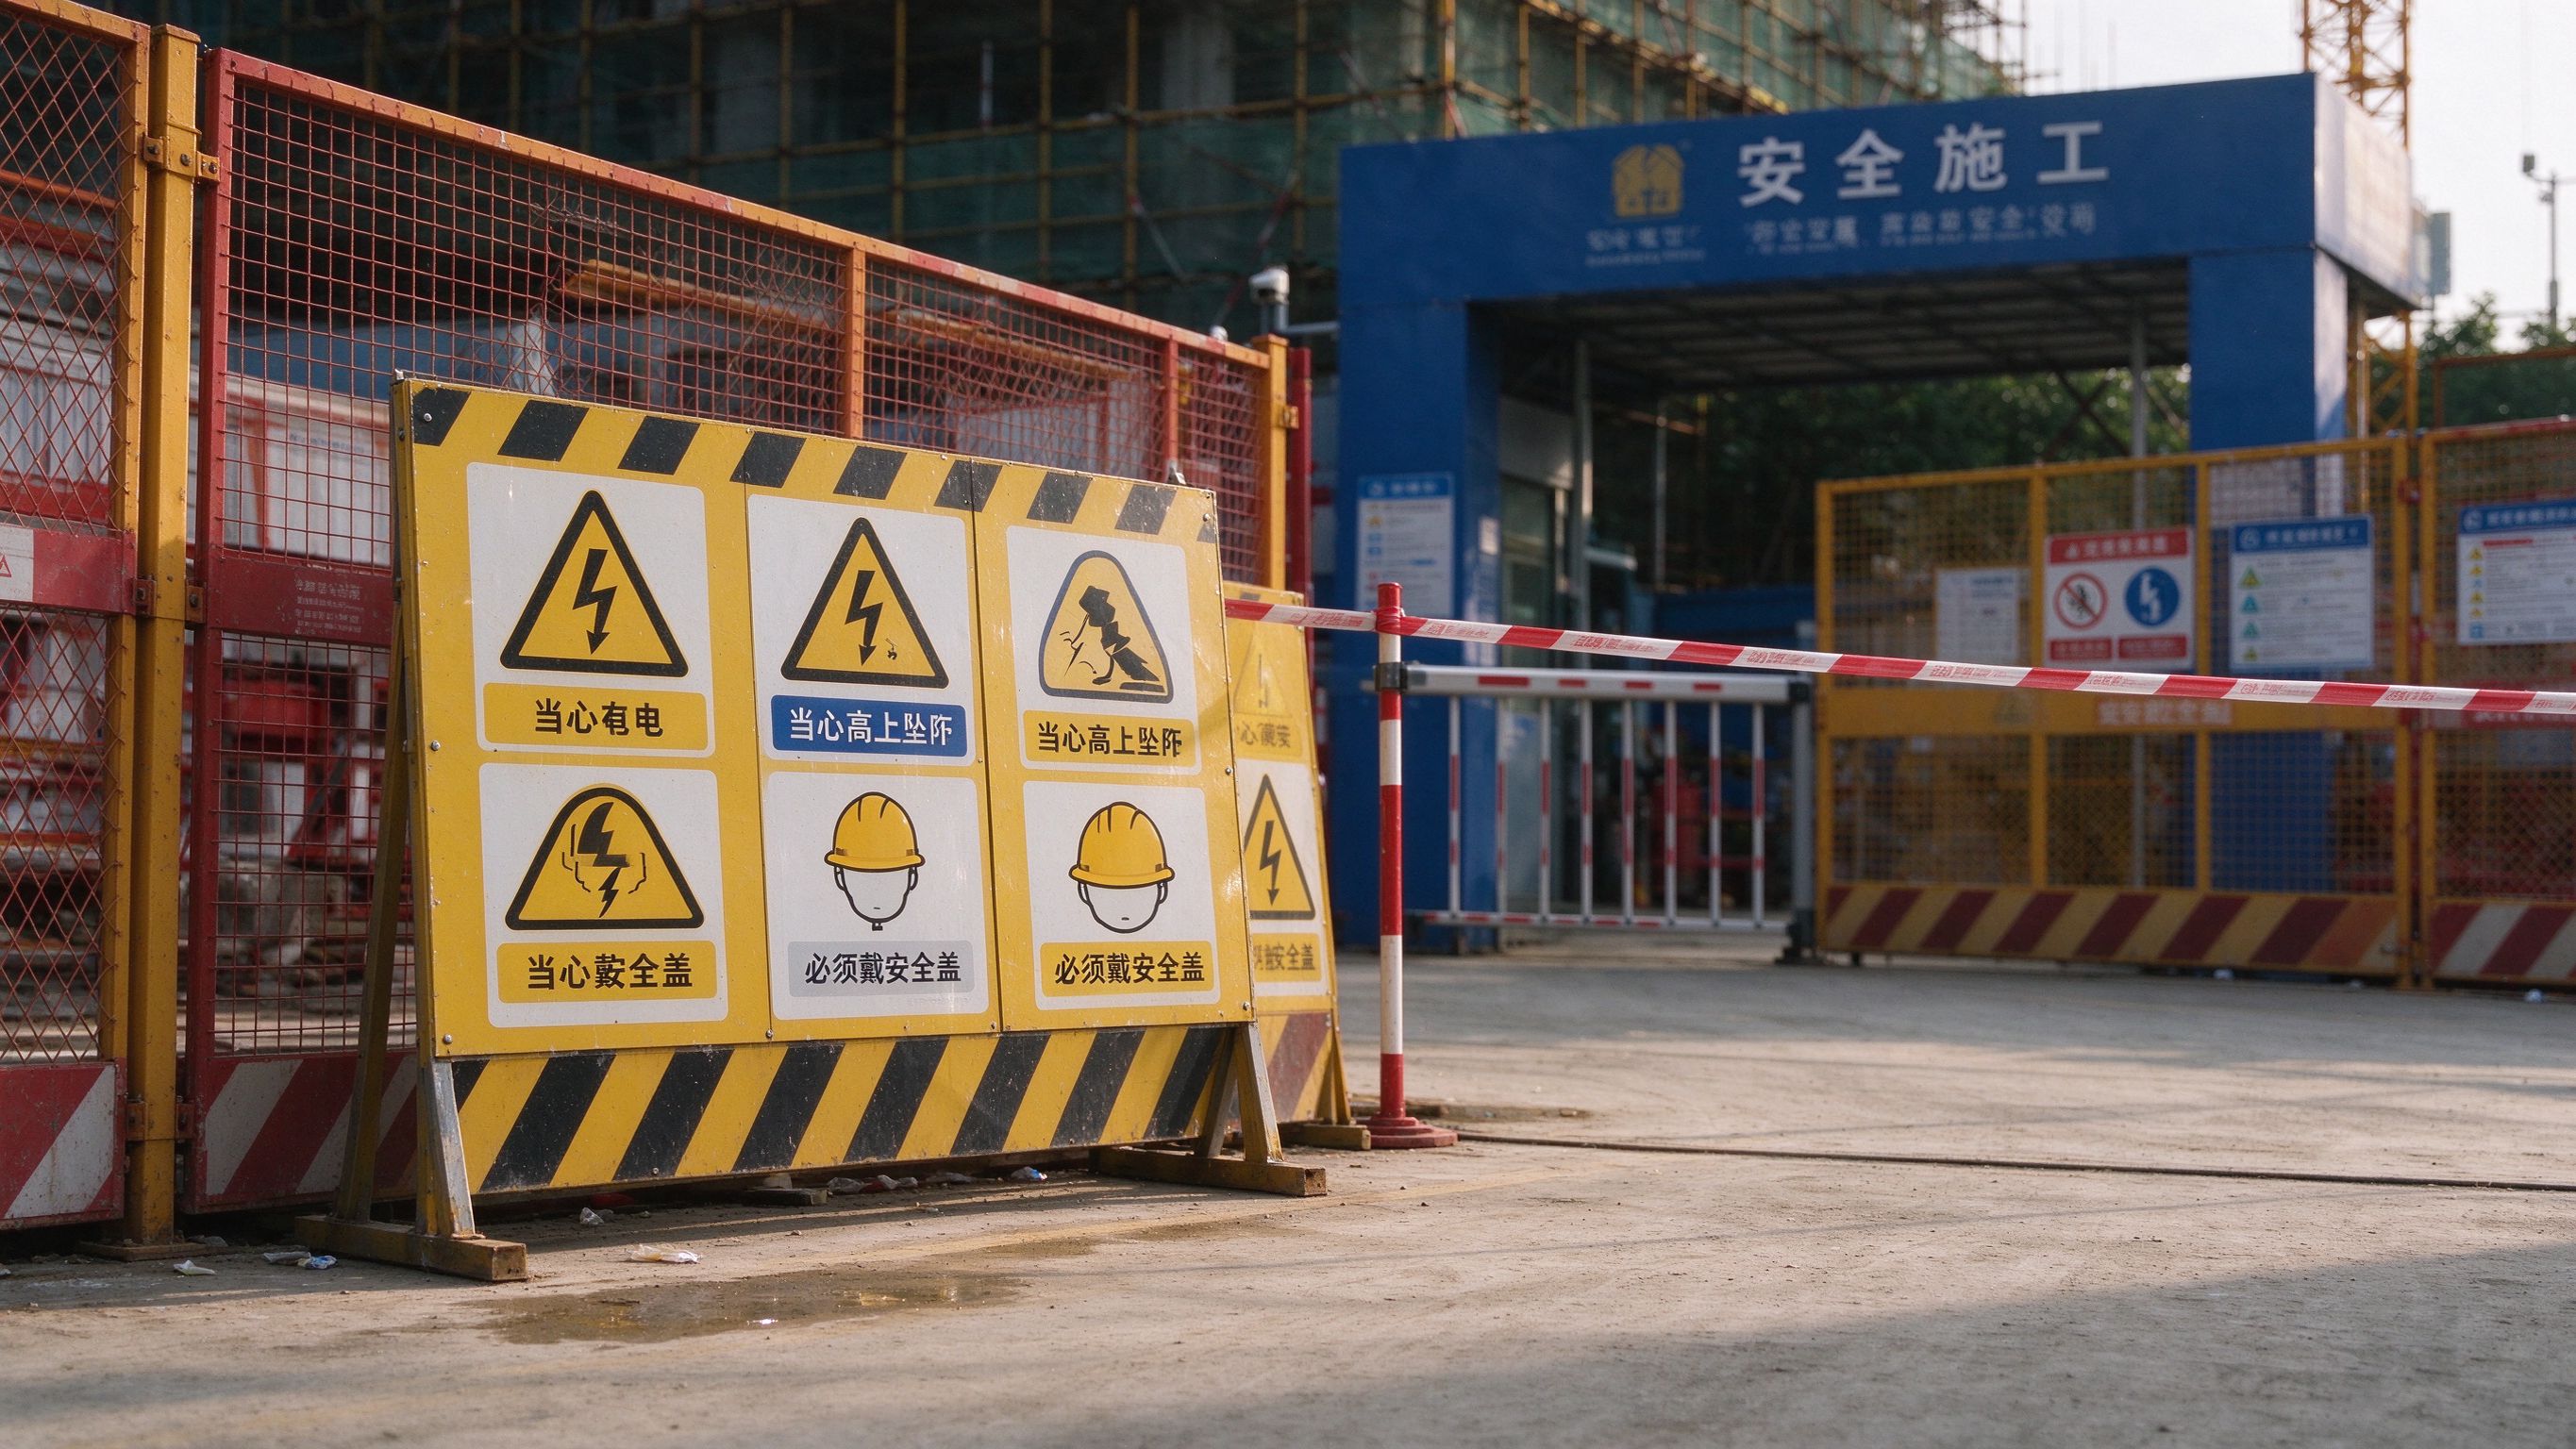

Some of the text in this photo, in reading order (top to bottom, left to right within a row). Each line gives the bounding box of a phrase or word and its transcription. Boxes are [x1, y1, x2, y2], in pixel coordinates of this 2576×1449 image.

[1738, 122, 2108, 207] 安全施工
[1054, 951, 1205, 985] 必须戴安全盖
